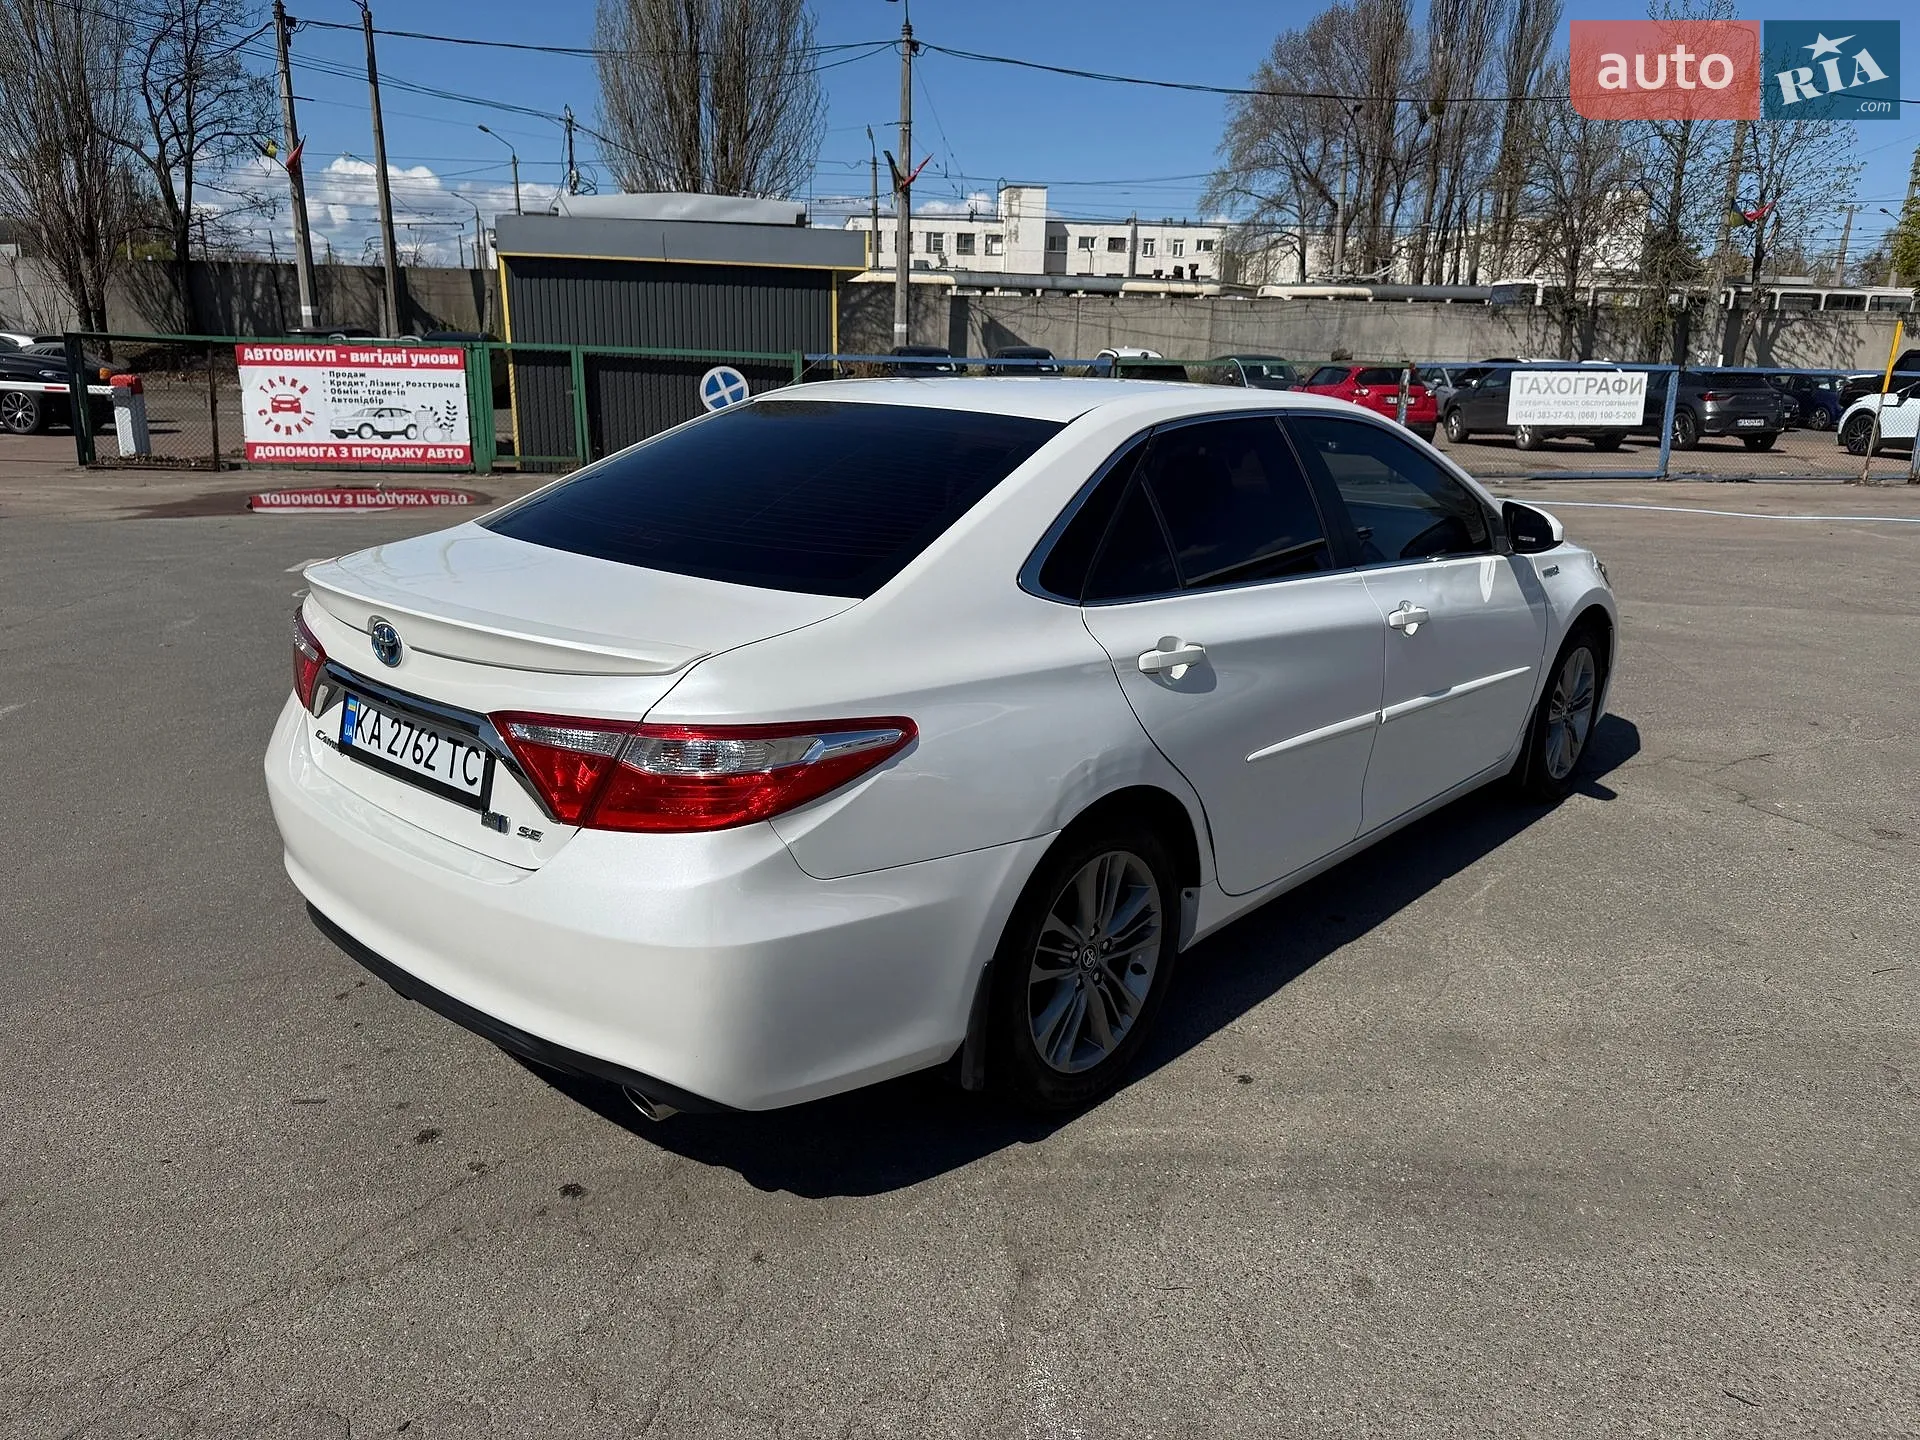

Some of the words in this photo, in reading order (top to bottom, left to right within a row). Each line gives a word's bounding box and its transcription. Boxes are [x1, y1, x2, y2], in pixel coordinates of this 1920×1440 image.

[244, 348, 336, 362] АВТОВИКУП
[350, 350, 406, 365] вигідні
[409, 352, 459, 367] умови
[368, 388, 406, 396] trade-in
[1516, 377, 1643, 395] ТАХОГРАФИ
[331, 396, 384, 405] Автопідбір
[254, 445, 337, 459] ДОПОМОГА
[352, 446, 423, 460] ПРОДАЖУ
[427, 448, 464, 459] АВТО
[344, 723, 353, 738] UA
[354, 702, 381, 750] KA
[387, 718, 439, 771] 2762
[447, 736, 481, 787] TC
[517, 826, 544, 843] SE
